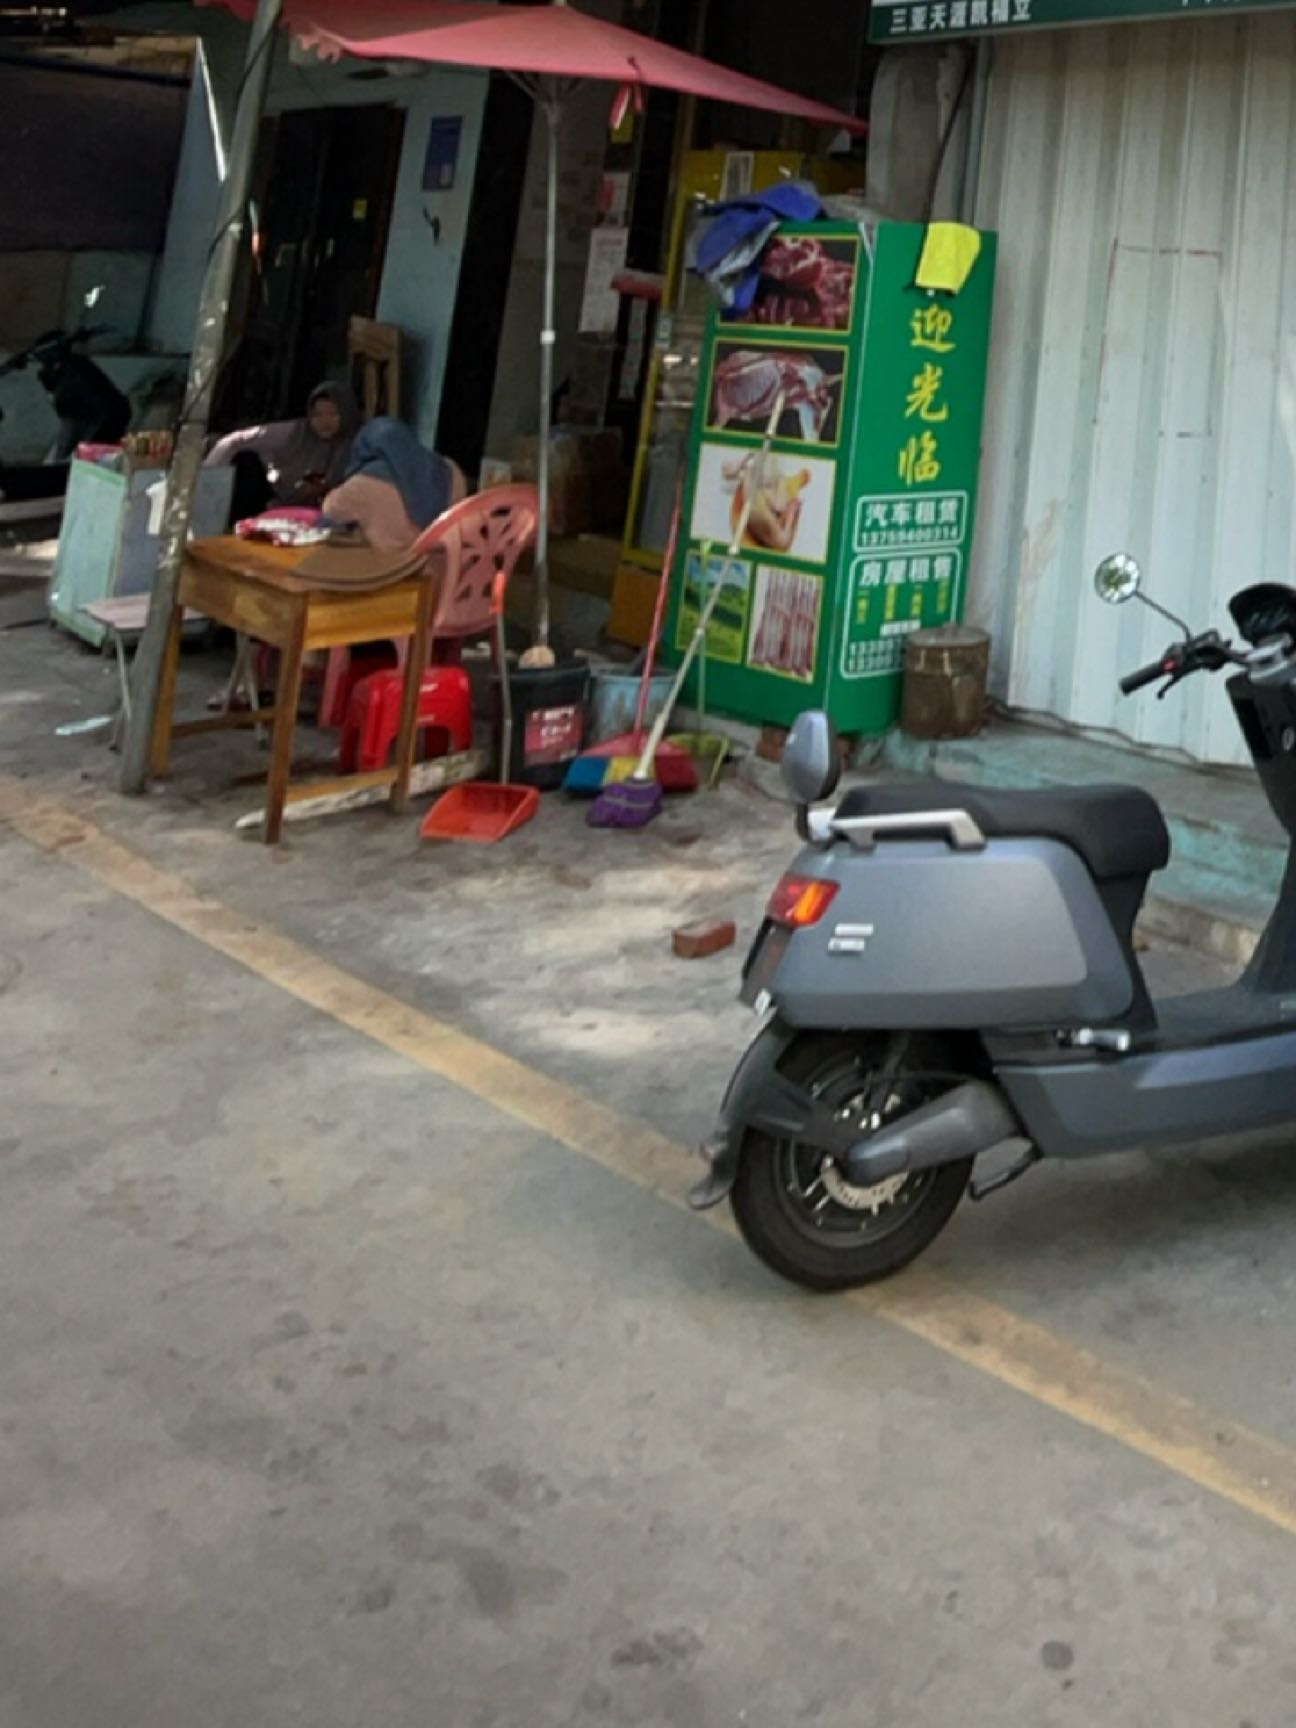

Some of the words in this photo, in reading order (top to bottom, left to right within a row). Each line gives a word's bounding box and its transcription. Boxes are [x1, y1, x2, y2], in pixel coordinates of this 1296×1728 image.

[897, 304, 958, 486] 迎光临
[864, 498, 959, 528] 汽车租赁
